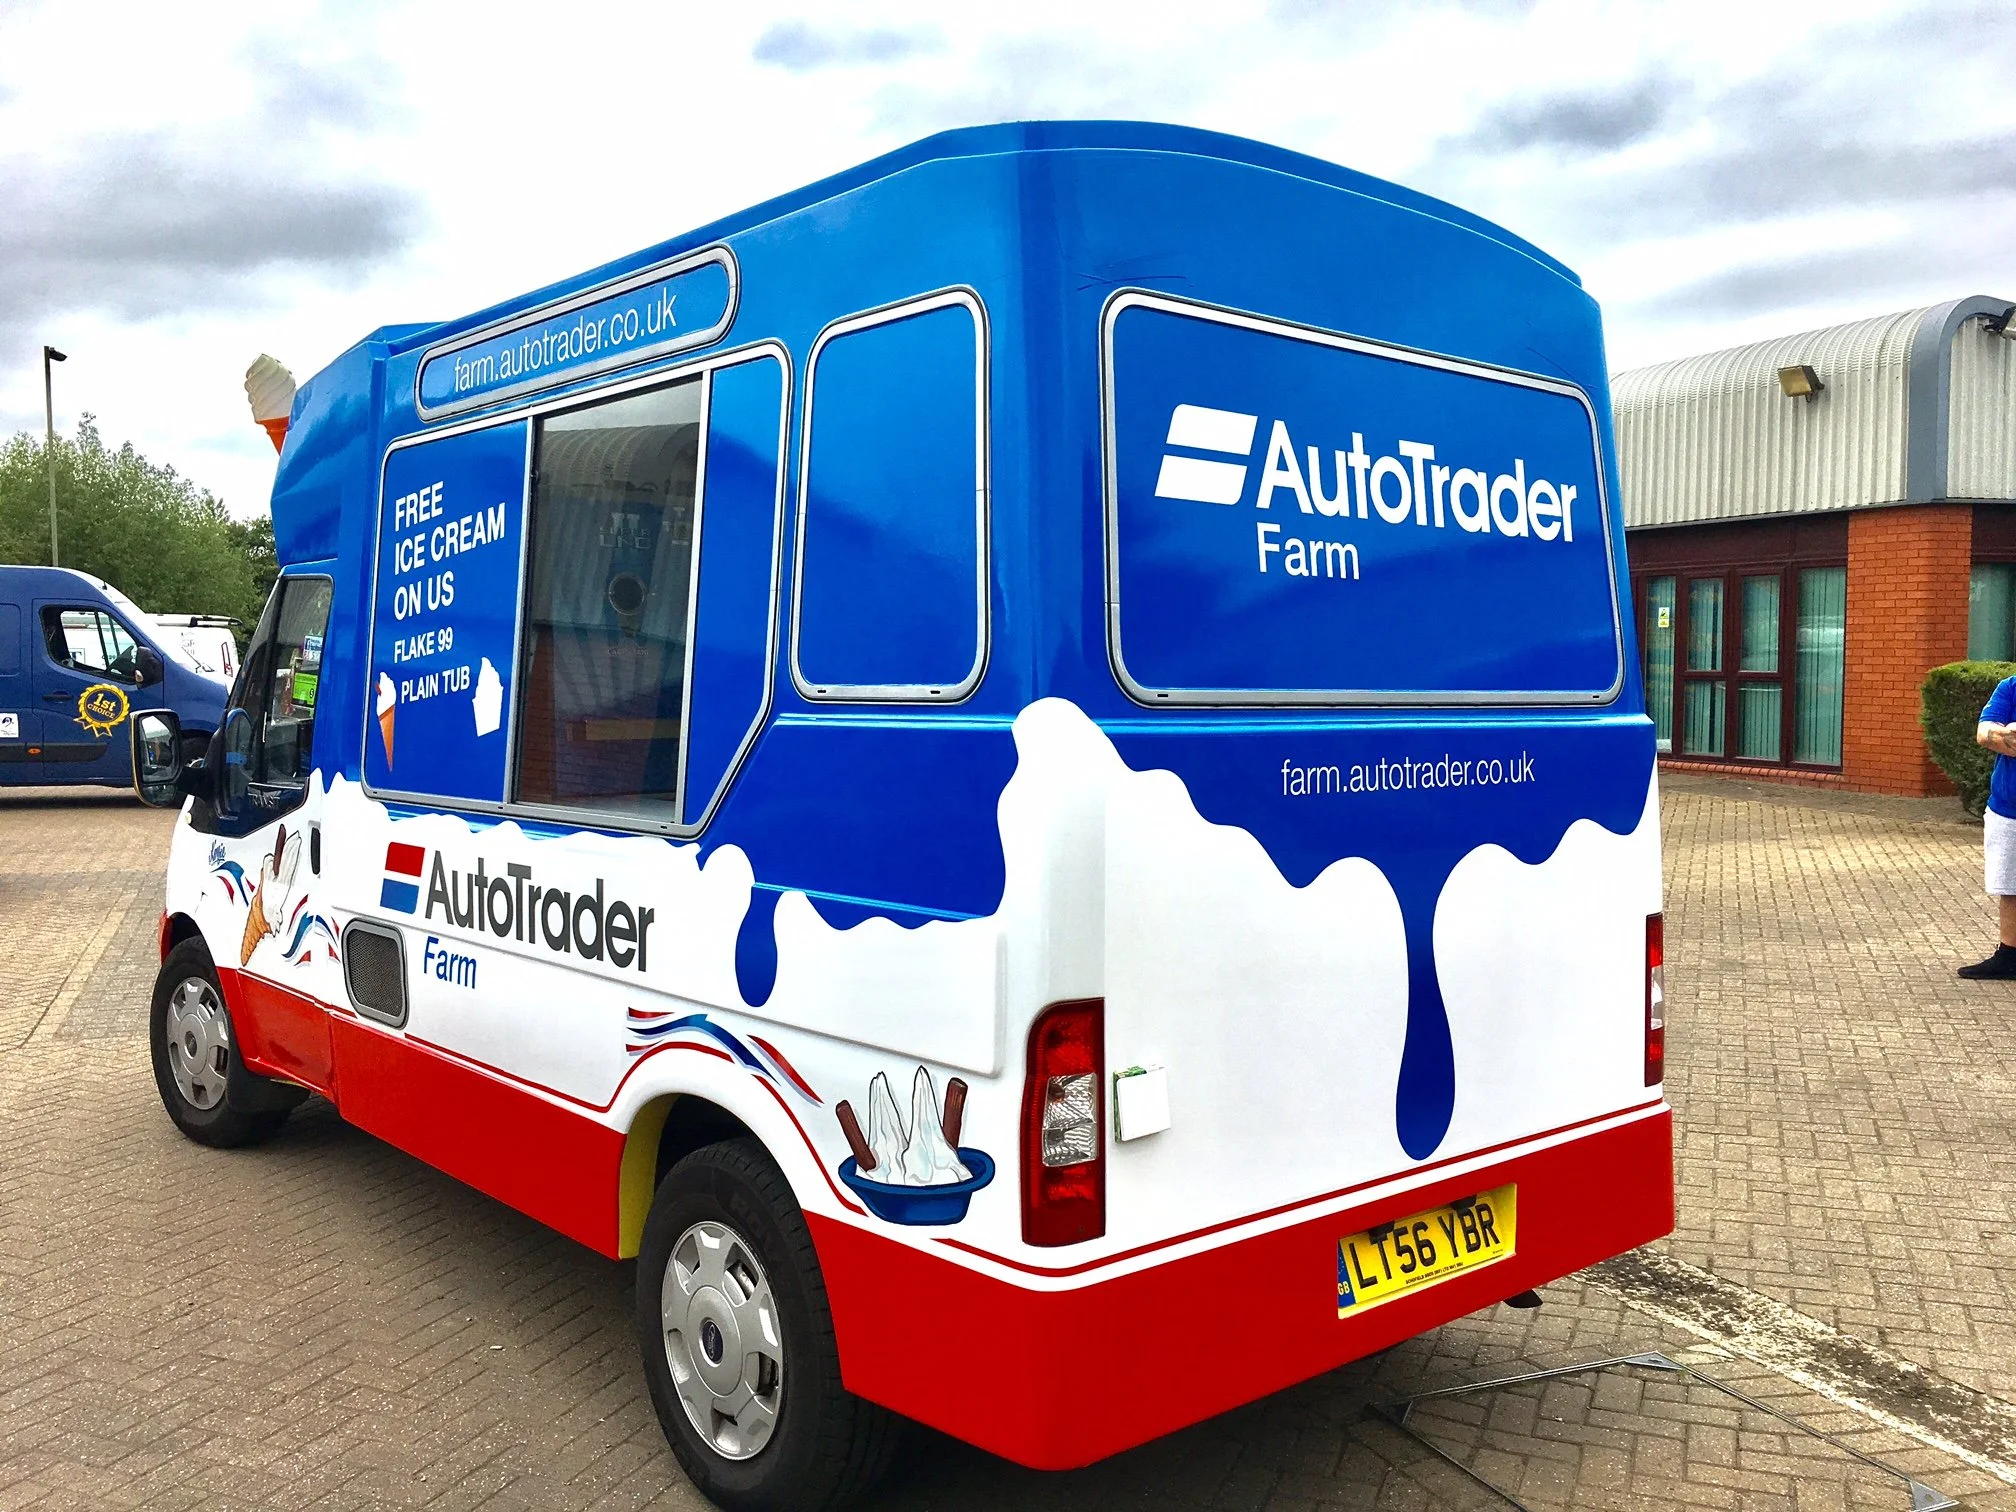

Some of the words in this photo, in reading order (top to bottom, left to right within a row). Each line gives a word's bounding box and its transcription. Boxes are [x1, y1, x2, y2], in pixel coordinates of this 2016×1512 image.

[454, 286, 678, 393] farm.autotrader.co.uk
[394, 480, 444, 532] FREE
[1255, 419, 1578, 543] AutoTrader
[394, 532, 426, 576] ICE
[430, 502, 506, 563] CREAM
[1256, 521, 1360, 580] Farm
[393, 580, 422, 621] ON
[427, 570, 455, 612] US
[393, 631, 435, 664] FLAKE
[437, 626, 453, 652] 99
[93, 693, 116, 712] 1st
[400, 672, 439, 704] PLAIN
[442, 665, 471, 696] TUB
[87, 703, 116, 719] CHOICE
[1281, 750, 1536, 796] farm.autotrader.co.uk
[424, 849, 655, 973] AutoTrader
[423, 935, 477, 990] Farm
[1348, 1220, 1437, 1290] LT56
[1437, 1202, 1501, 1258] YBR
[1337, 1280, 1351, 1296] GB
